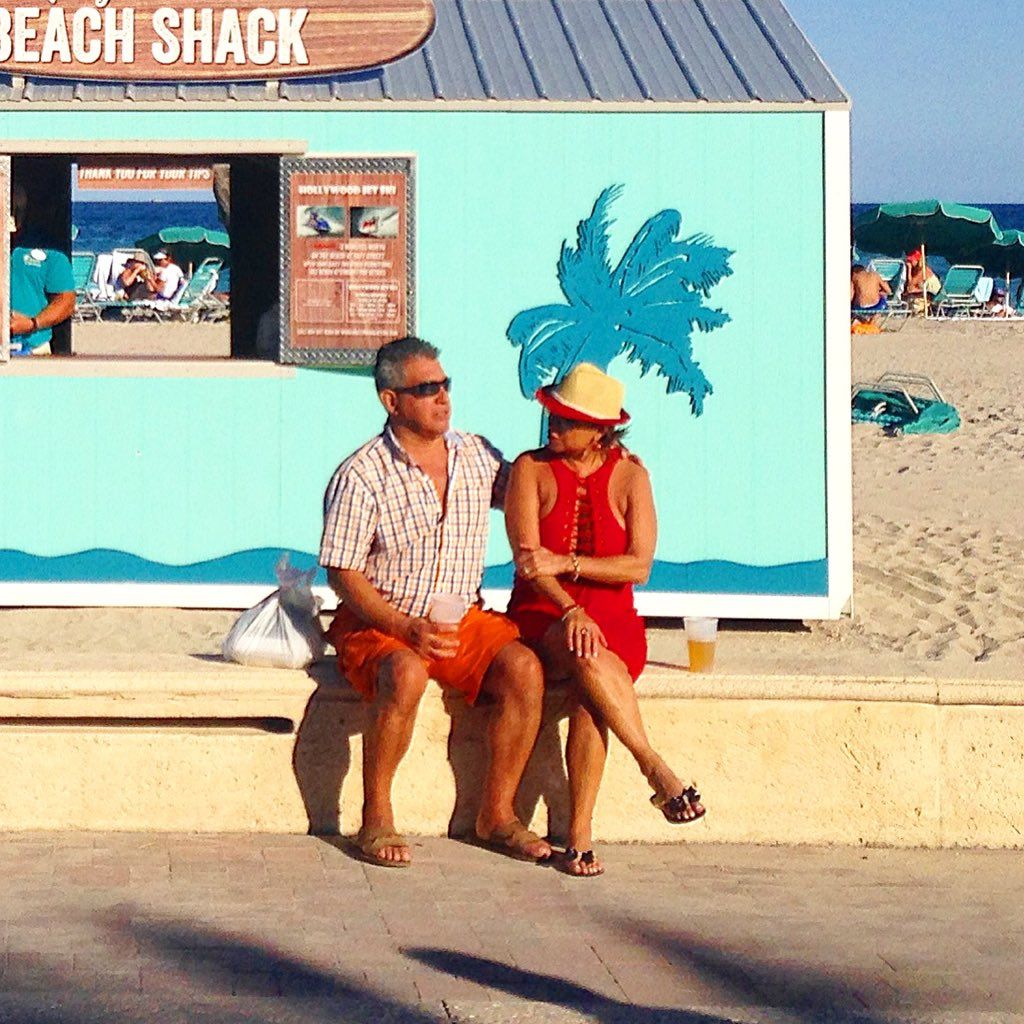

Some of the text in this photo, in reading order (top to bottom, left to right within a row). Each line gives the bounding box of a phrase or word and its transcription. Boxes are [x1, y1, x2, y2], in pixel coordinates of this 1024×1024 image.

[150, 6, 311, 65] SHACK
[79, 168, 211, 180] THANK YOU FOR YOUR TIPS
[298, 185, 396, 195] HOLLYWOOD JET SKI
